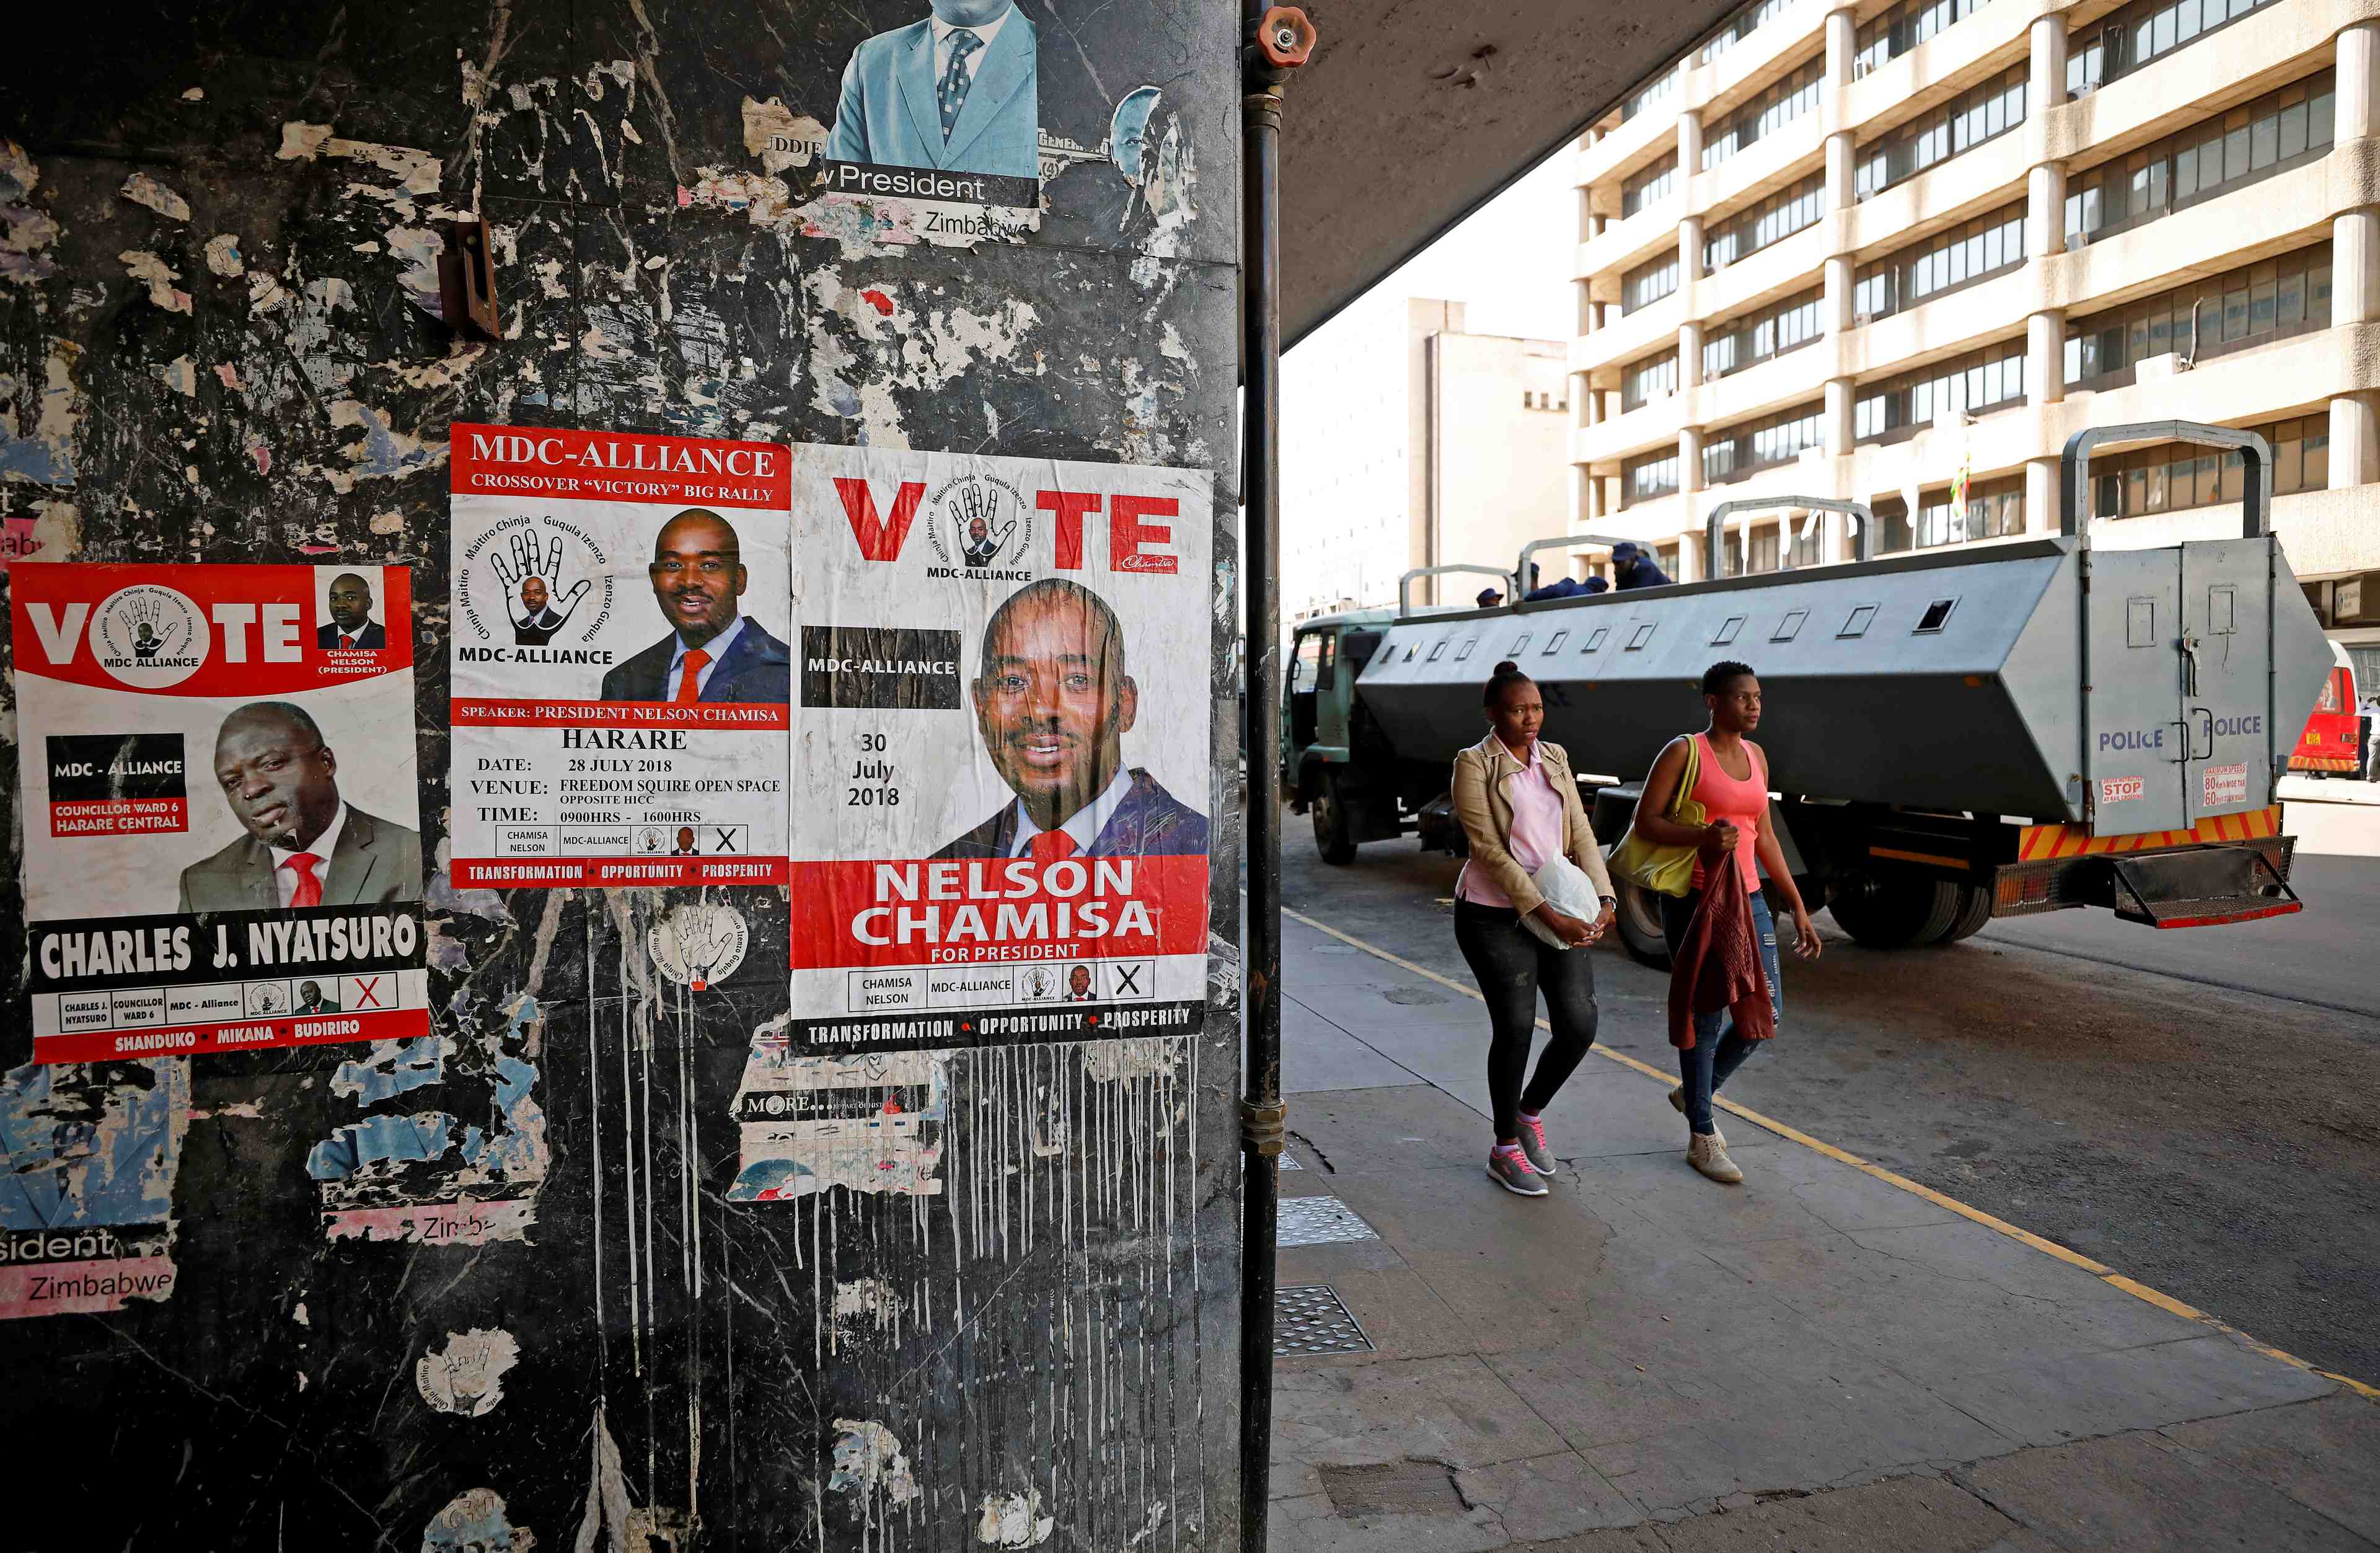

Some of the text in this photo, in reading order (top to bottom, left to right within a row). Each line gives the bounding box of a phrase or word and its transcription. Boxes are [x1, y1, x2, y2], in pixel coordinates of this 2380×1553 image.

[840, 164, 985, 200] President
[470, 433, 775, 477] MDC-ALLIANCE
[471, 473, 580, 491] CROSSOVER
[684, 485, 714, 498] BIG
[718, 487, 774, 502] RALLY
[932, 474, 976, 506] Maitiro Chinja
[984, 474, 1027, 510] Guqula Izenzo
[465, 515, 531, 560] Maitiro Chinja
[544, 515, 606, 565] Guqula Izenzo
[927, 567, 1031, 582] MDC-ALLIANCE
[123, 588, 144, 597] Chinja
[149, 587, 172, 600] Guqula
[458, 569, 491, 640] Chinja Maitiro
[581, 575, 614, 642] Izenzo Guqula
[104, 657, 199, 668] MDC ALLIANCE
[459, 647, 613, 665] MDC-ALLIANCE
[318, 665, 387, 675] (PRESIDENT)
[807, 657, 956, 676] MDC-ALLIANCE
[461, 706, 779, 722] SPEAKER: PRESIDENT NELSON CHAMISA
[2203, 715, 2261, 738] POLICE
[560, 728, 688, 751] HARARE
[862, 734, 887, 752] 30
[2099, 728, 2163, 752] POLICE
[55, 761, 94, 778] MDC
[107, 759, 183, 776] ALLIANCE
[477, 758, 672, 772] DATE: 28 JULY 2018
[852, 759, 895, 784] July
[470, 779, 781, 795] VENUE: FREEDOM SQUIRE OPEN SPACE
[2104, 782, 2141, 795] STOP
[2205, 777, 2215, 790] 80
[560, 794, 654, 805] OPPOSITE HICC
[847, 787, 900, 807] 2018
[2205, 792, 2216, 805] 60
[56, 802, 179, 817] COUNCILLOR WARD 6
[477, 807, 538, 821] TIME:
[560, 811, 620, 823] 0900HRS
[643, 810, 701, 823] 1600HRS
[56, 815, 180, 833] HARARE CENTRAL
[507, 831, 548, 840] CHAMISA
[563, 836, 628, 845] MDC-ALLIANCE
[510, 843, 545, 852] NELSON
[469, 864, 772, 880] TRANSFORMATION OPPORTUNITY PROSPERITY
[875, 860, 1134, 903] NELSON
[851, 900, 1155, 945] CHAMISA
[40, 914, 416, 980] CHARLES J. NYATSURO
[931, 943, 1080, 963] FOR PRESIDENT
[862, 976, 912, 990] CHAMISA
[931, 979, 1011, 993] MDC-ALLIANCE
[65, 1001, 108, 1013] CHARLES J.
[113, 997, 164, 1008] COUNCILLOR
[170, 1001, 190, 1011] MDC
[202, 998, 239, 1009] Alliance
[865, 993, 909, 1006] NELSON
[66, 1014, 107, 1025] NYATSURO
[124, 1010, 155, 1021] WARD 6
[808, 1008, 1190, 1043] TRANSFORMATION OPPORTUNITY PROSPERITY
[115, 1019, 360, 1052] SHANDUKO MIKANA BUDIRIRO
[29, 1272, 172, 1301] Zimbabwe
